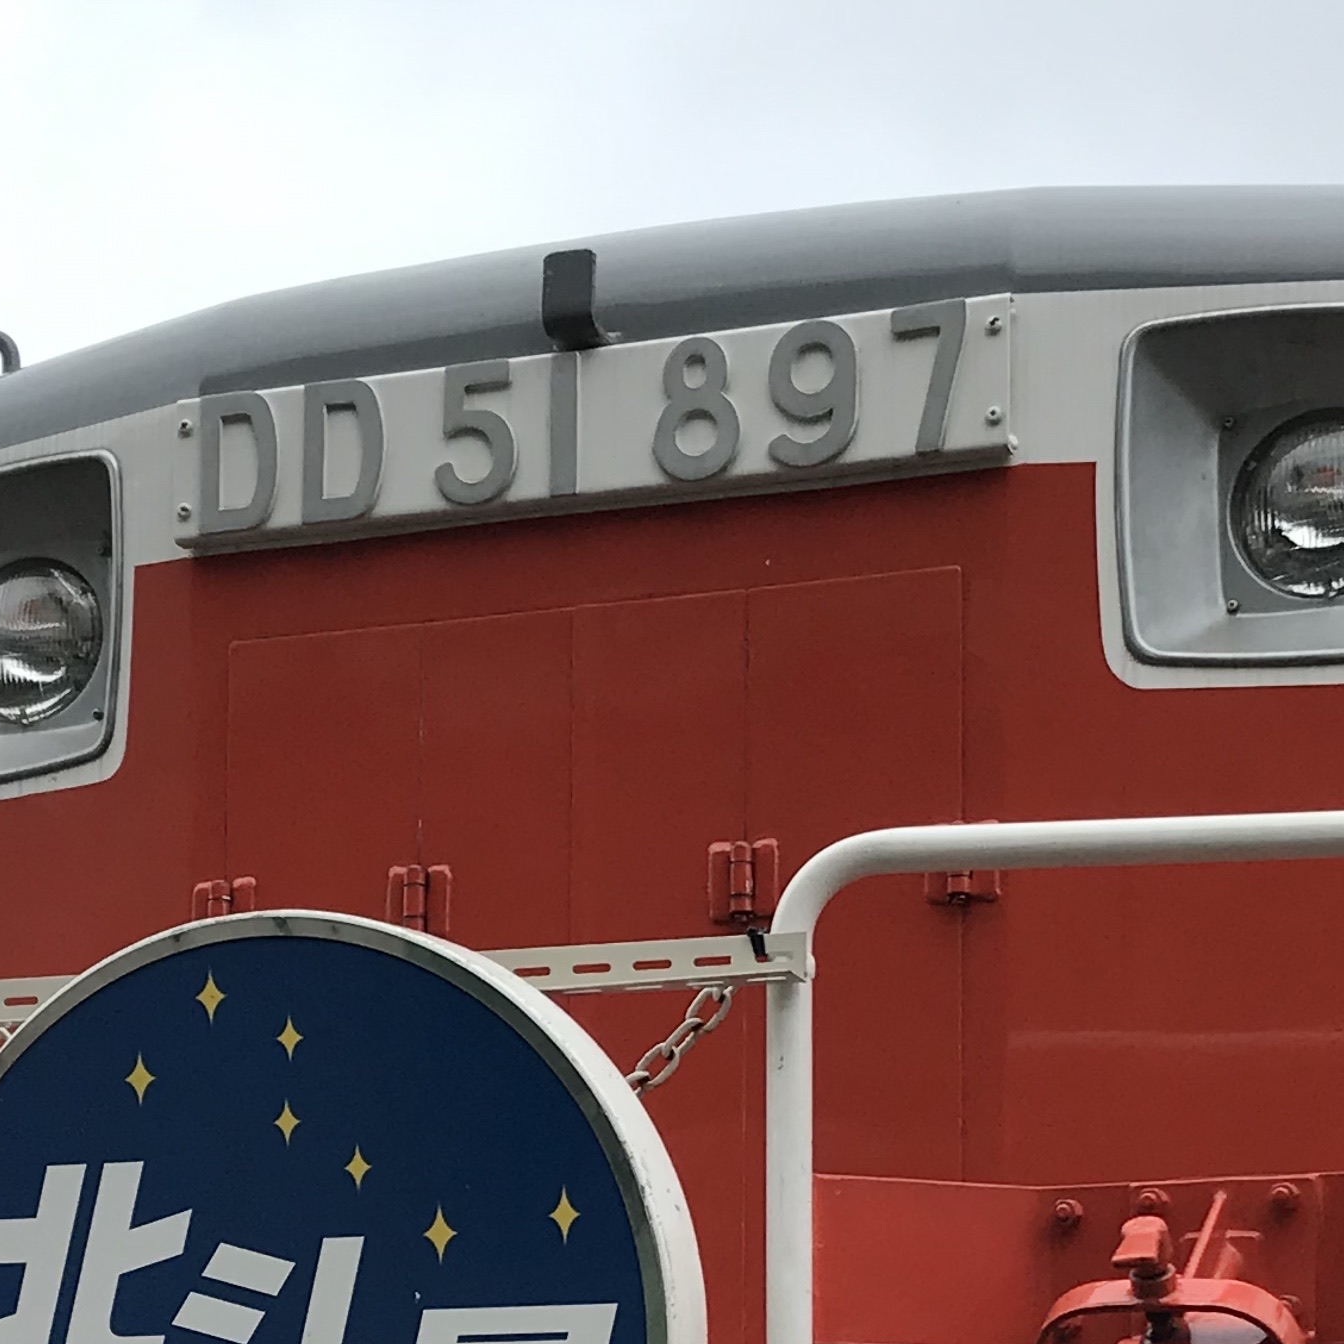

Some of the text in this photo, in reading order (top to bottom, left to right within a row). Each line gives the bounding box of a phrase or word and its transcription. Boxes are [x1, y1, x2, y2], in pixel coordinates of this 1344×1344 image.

[200, 299, 967, 534] DD 51 897
